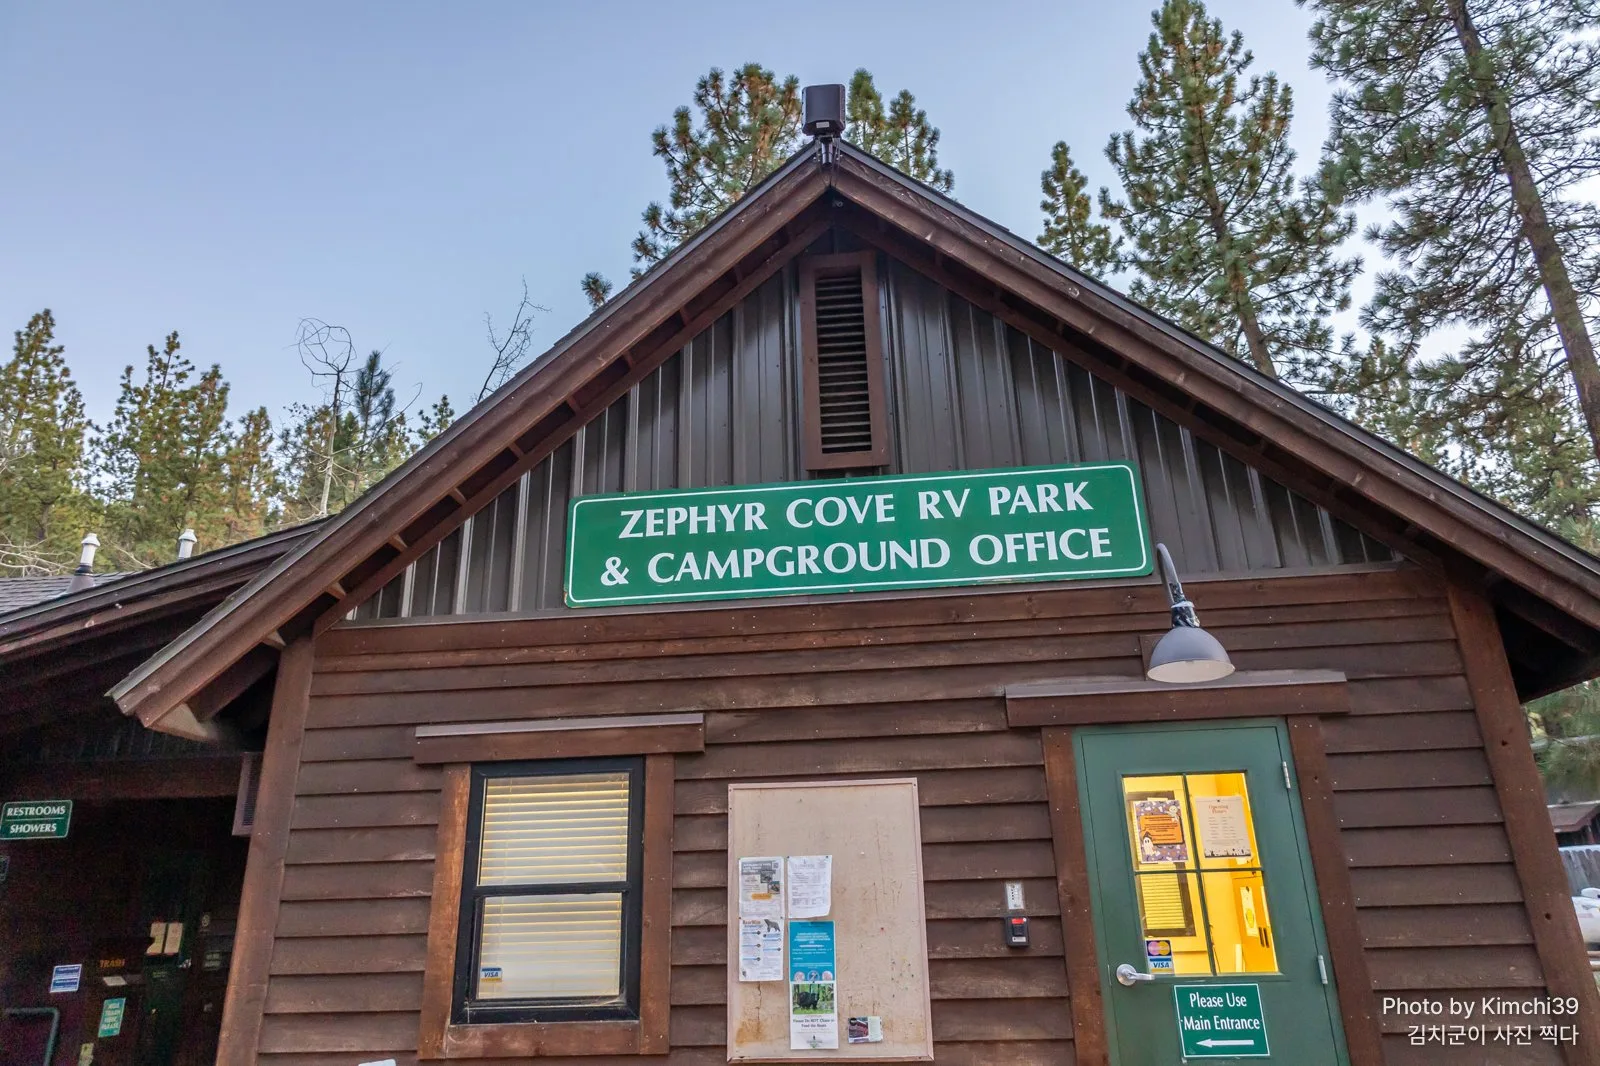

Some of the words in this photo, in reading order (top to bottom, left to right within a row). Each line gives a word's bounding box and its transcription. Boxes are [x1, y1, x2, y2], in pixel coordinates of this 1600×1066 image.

[618, 501, 769, 540] ZEPHYR
[785, 494, 895, 530] COVE
[918, 488, 971, 520] RV
[990, 481, 1094, 516] PARK
[600, 556, 630, 587] &
[647, 537, 951, 584] CAMPGROUND
[968, 527, 1113, 566] OFFICE
[6, 805, 66, 816] RESTROOMS
[9, 823, 57, 834] SHOWERS
[1189, 992, 1224, 1008] Please
[1226, 992, 1247, 1007] Use
[1183, 1016, 1212, 1031] Main
[1213, 1015, 1261, 1030] Entrance
